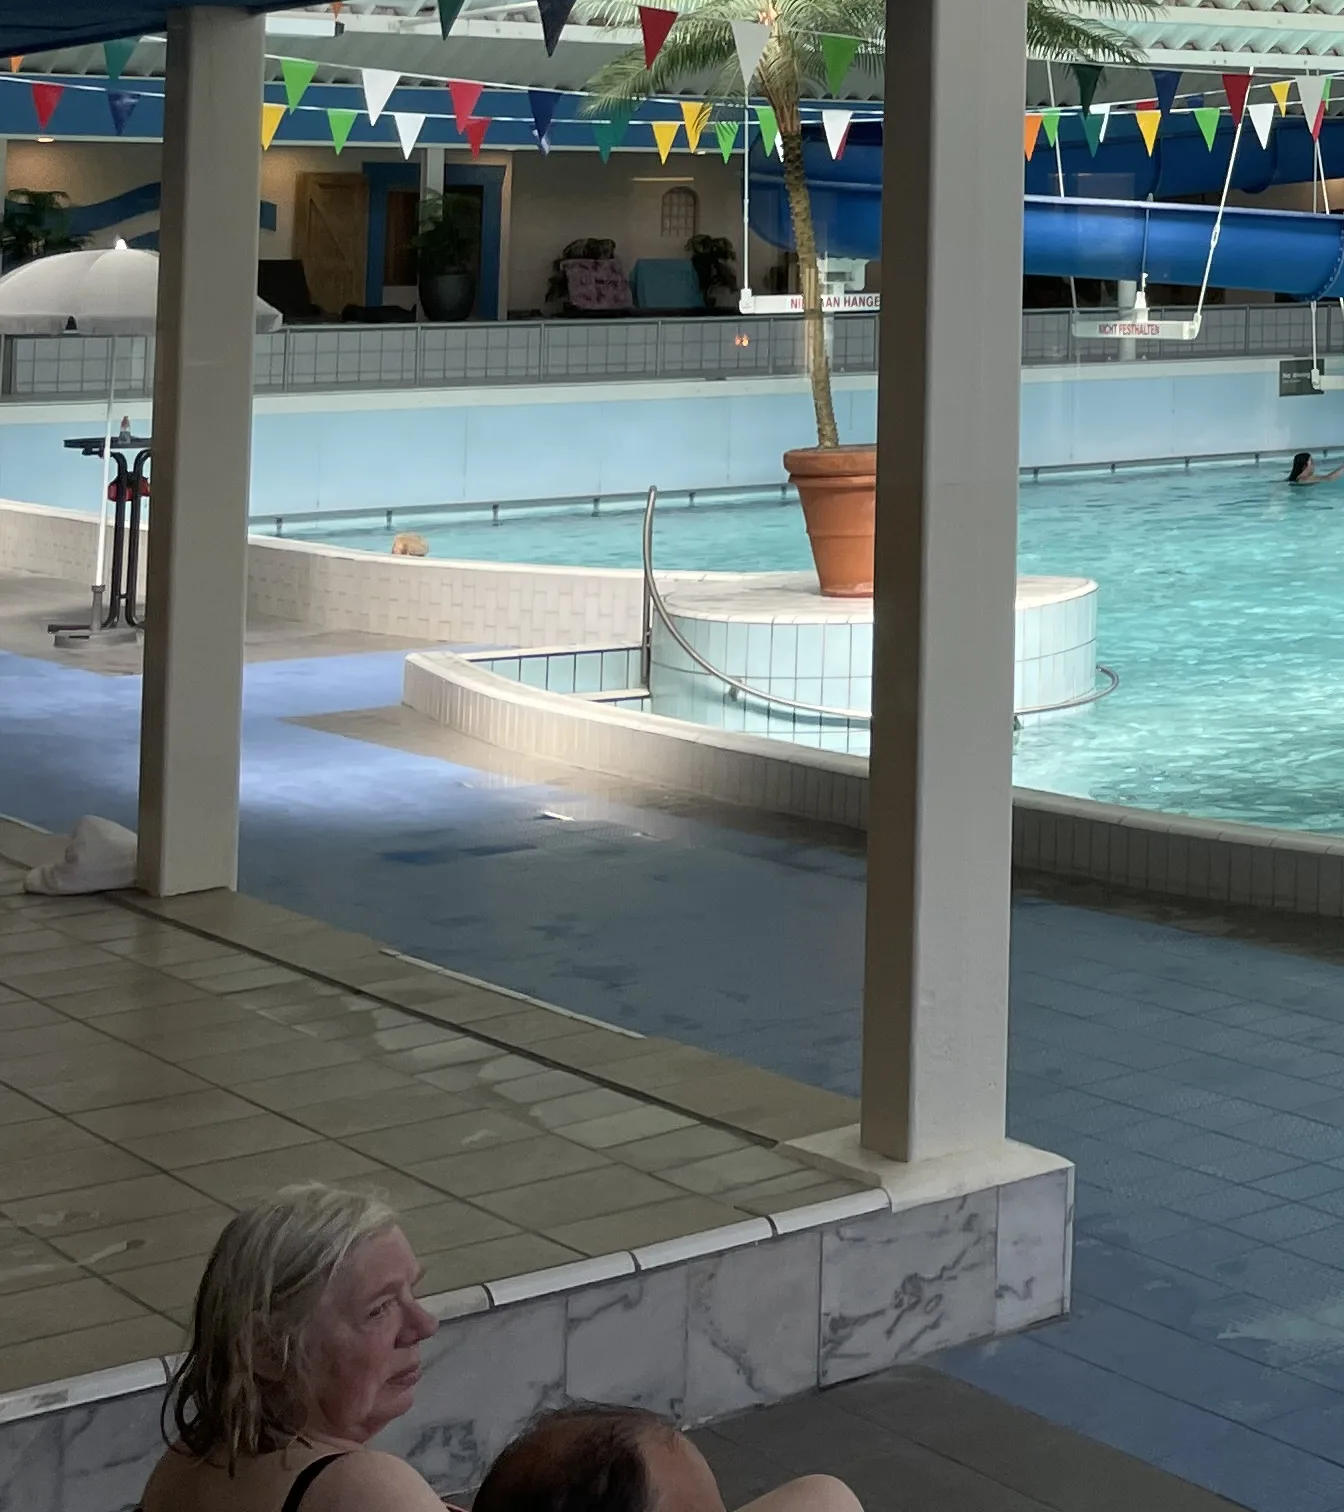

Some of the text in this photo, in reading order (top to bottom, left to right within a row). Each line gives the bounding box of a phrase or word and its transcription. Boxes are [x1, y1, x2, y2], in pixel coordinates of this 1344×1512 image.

[790, 295, 880, 309] NI AN HANGE
[1119, 324, 1159, 335] FESTHALTEN
